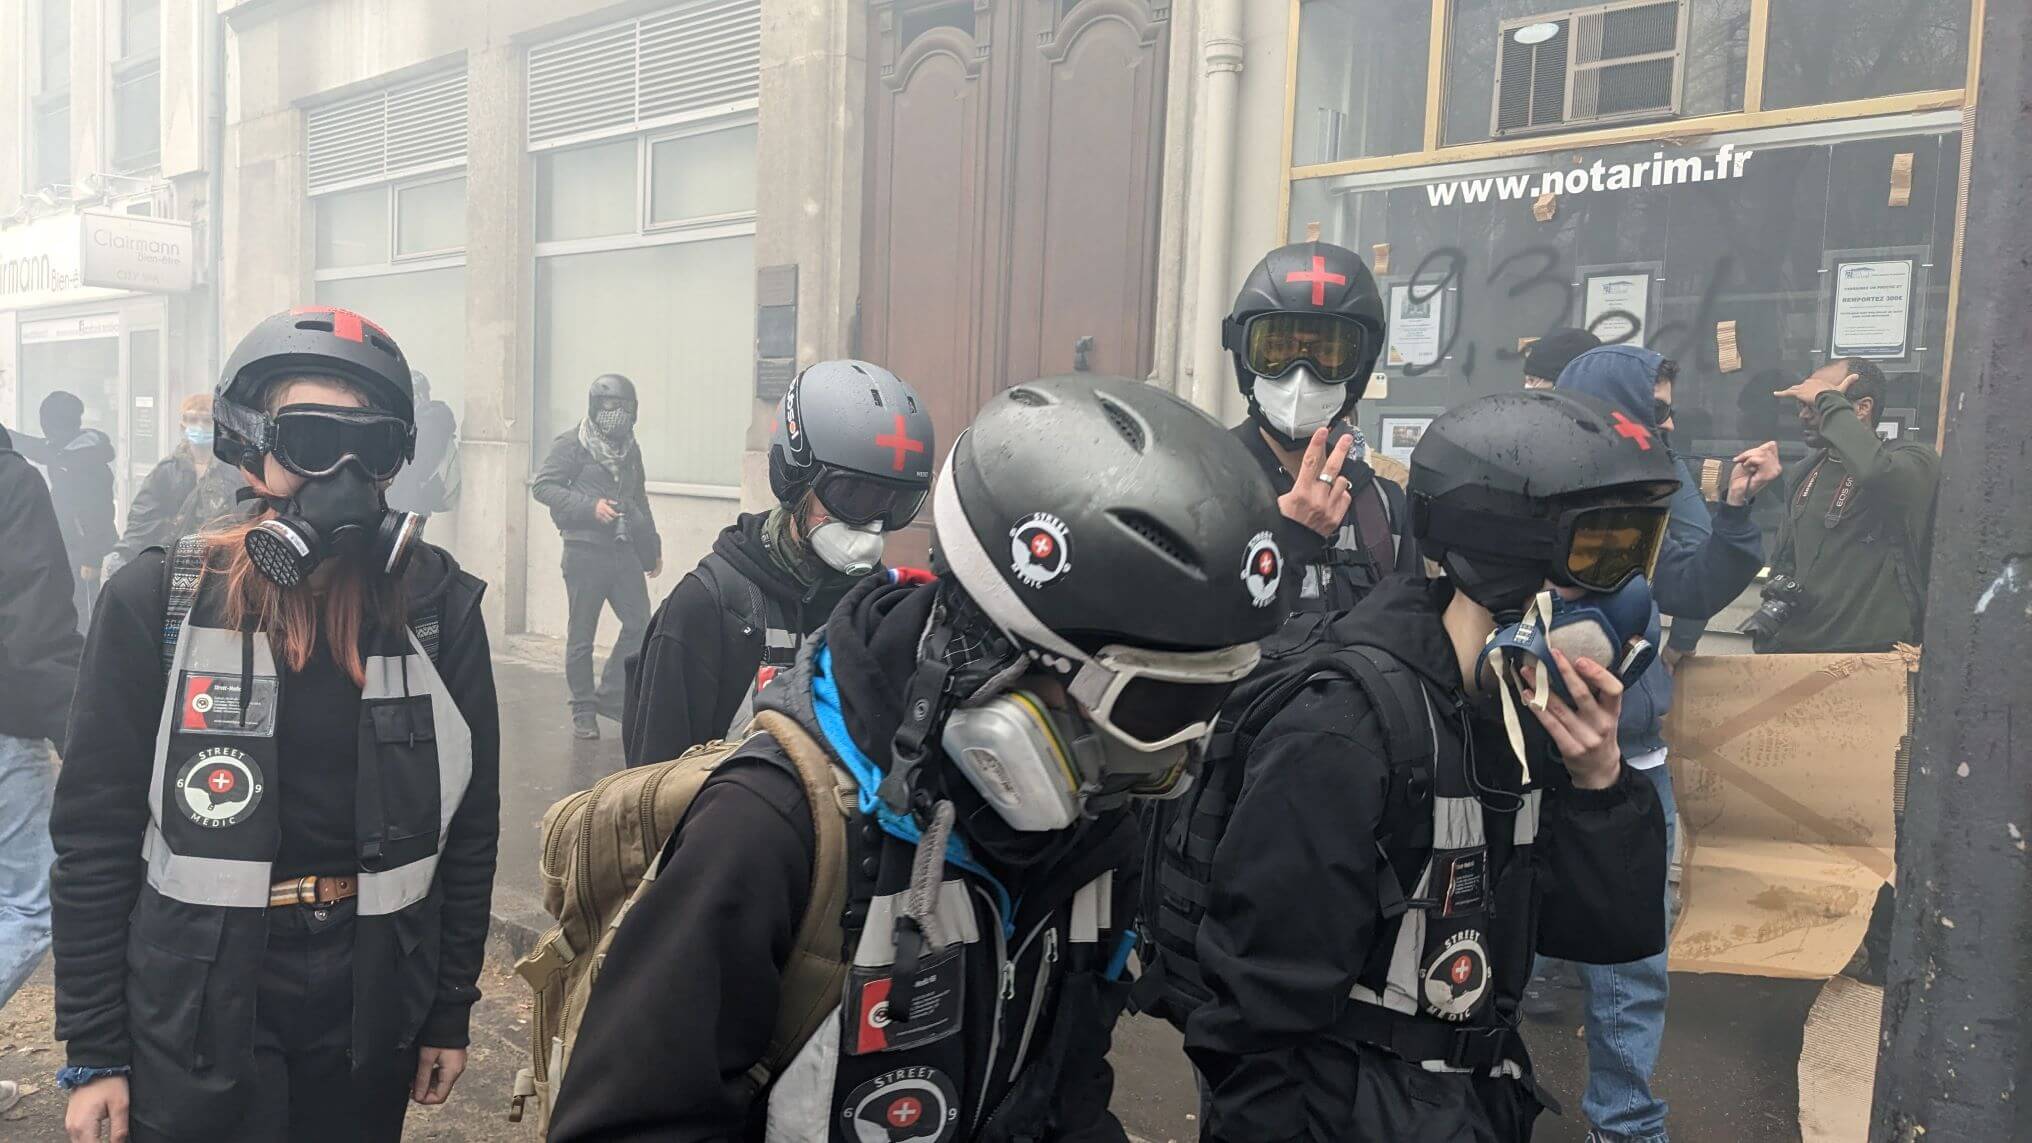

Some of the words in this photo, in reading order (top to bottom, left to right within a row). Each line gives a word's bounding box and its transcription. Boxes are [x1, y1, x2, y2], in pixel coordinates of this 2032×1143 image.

[1426, 144, 1753, 206] www.notarim.fr
[94, 229, 181, 255] Clairmann
[1034, 511, 1070, 536] STREET
[199, 747, 245, 760] STREET
[176, 778, 184, 788] 6
[255, 784, 262, 793] 9
[190, 812, 236, 827] MEDIC
[1444, 929, 1480, 950] STREET
[1426, 1004, 1471, 1022] MEDIC
[874, 1066, 936, 1087] STREET
[843, 1107, 853, 1118] 6
[948, 1108, 958, 1120] 9
